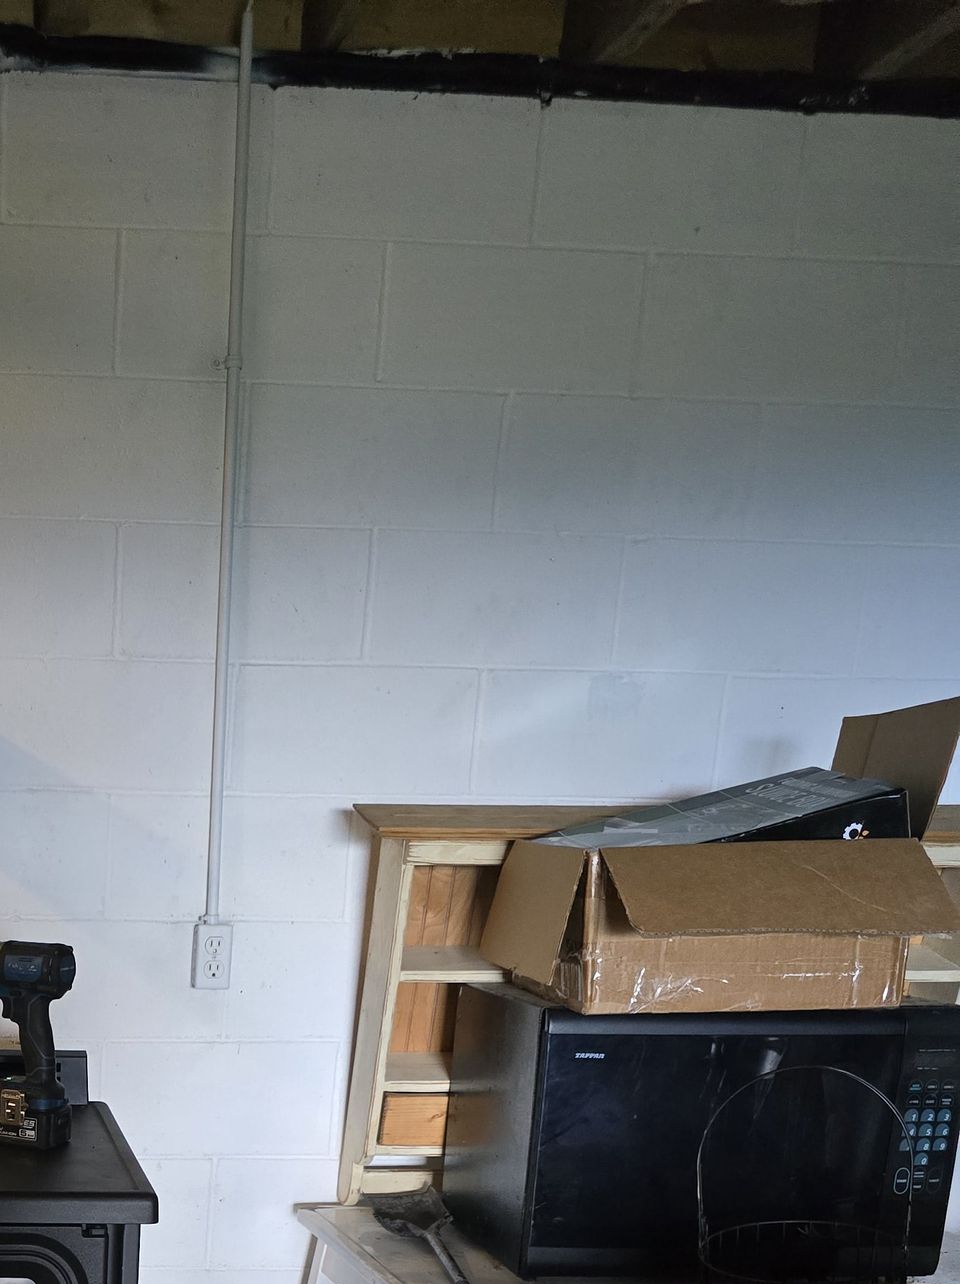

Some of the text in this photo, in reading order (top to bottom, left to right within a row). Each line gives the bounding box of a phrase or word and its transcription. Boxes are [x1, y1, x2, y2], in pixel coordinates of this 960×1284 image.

[911, 1113, 950, 1121] 1 2 3
[926, 1128, 932, 1136] 5
[942, 1128, 948, 1136] 6
[923, 1143, 945, 1151] 8 9
